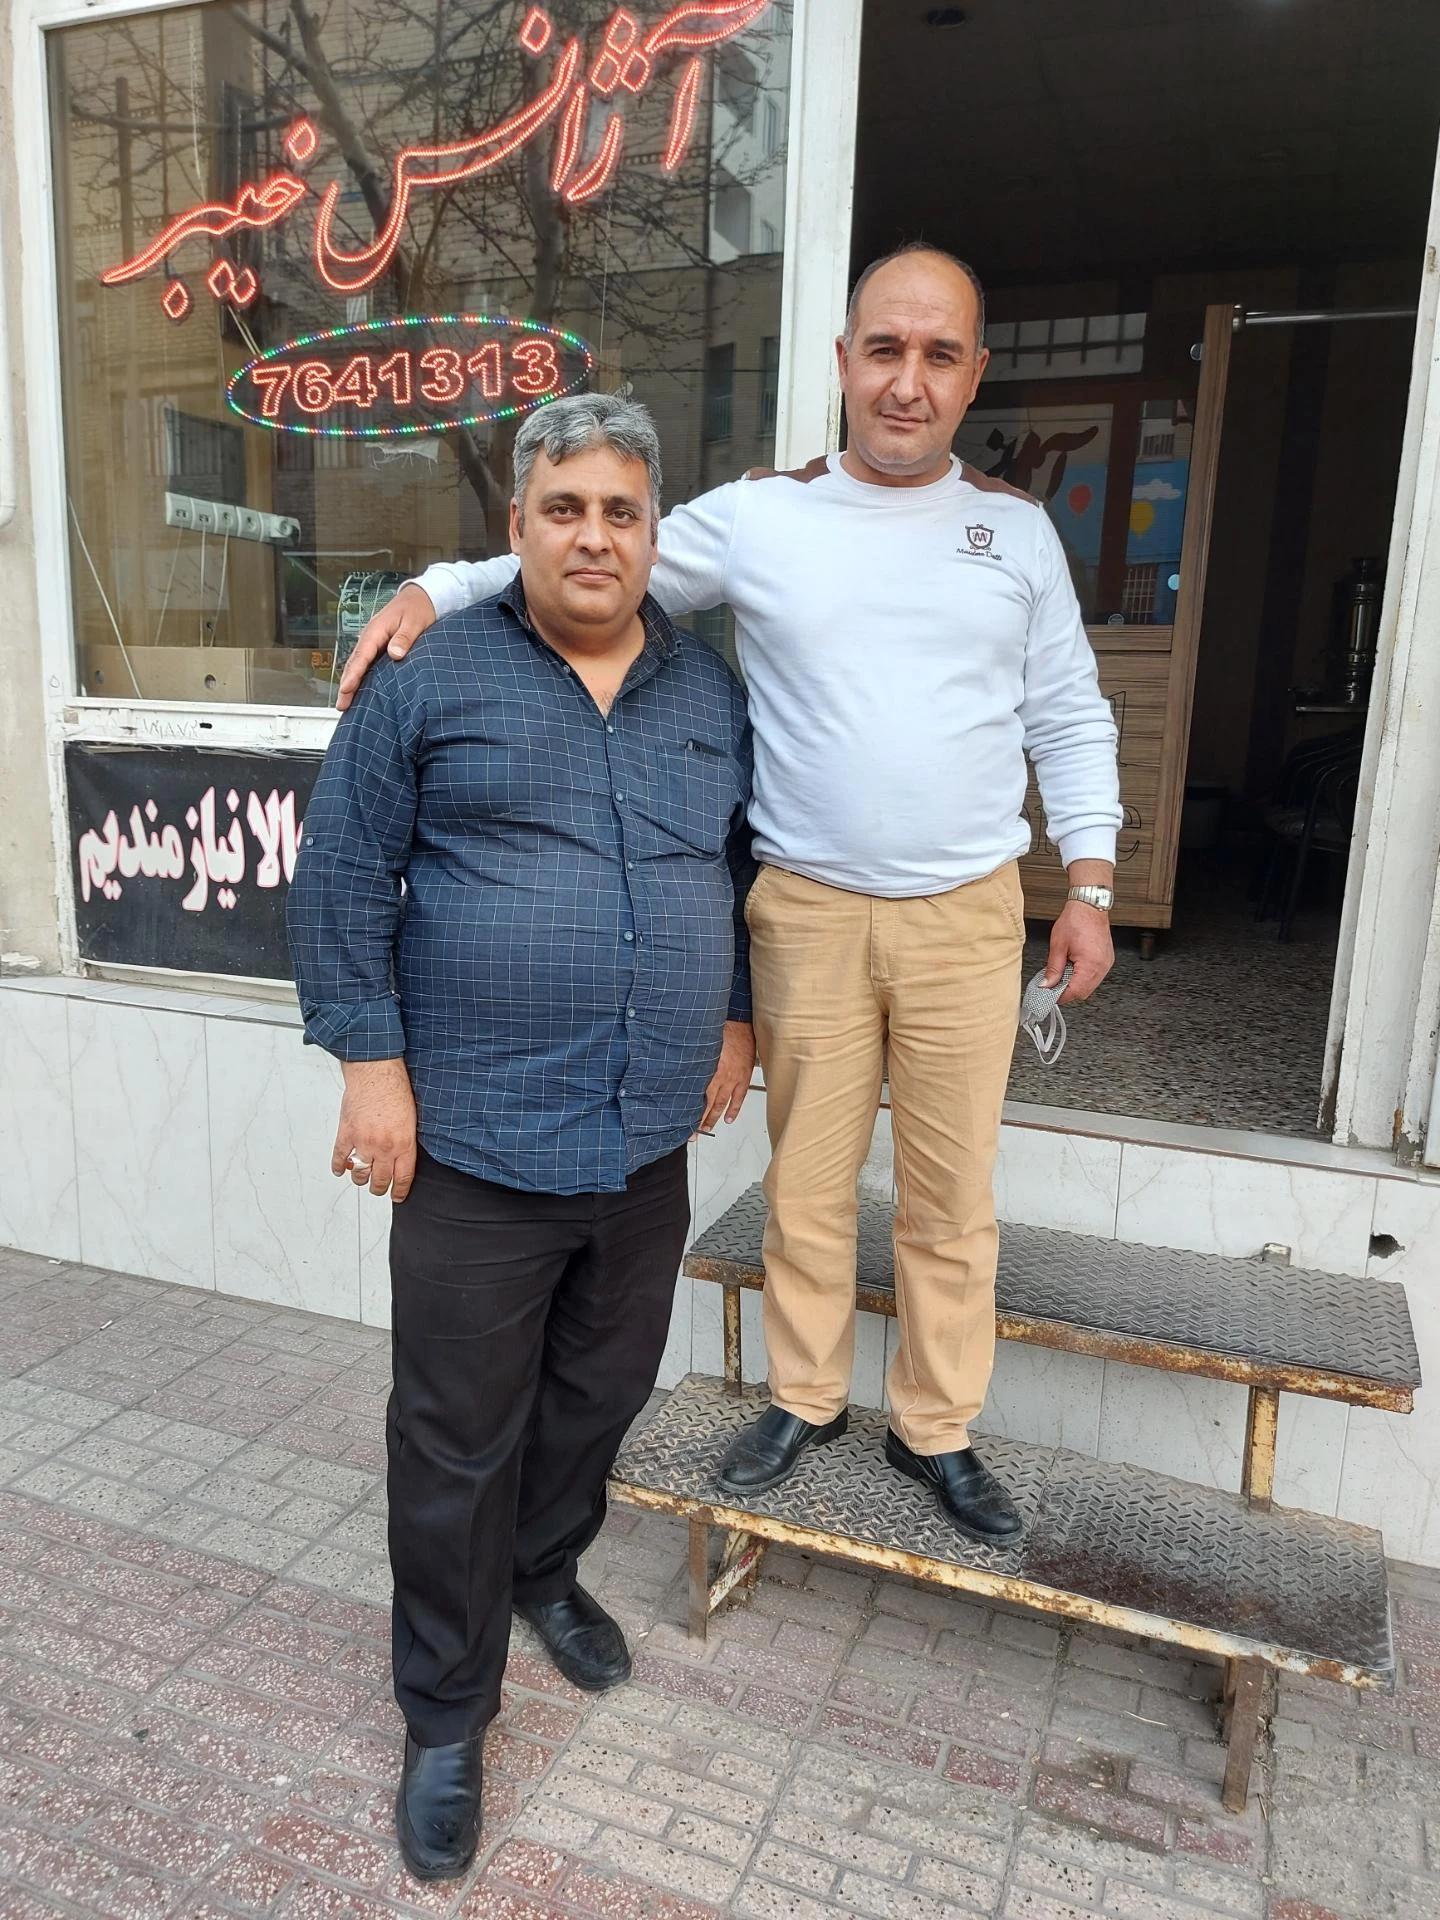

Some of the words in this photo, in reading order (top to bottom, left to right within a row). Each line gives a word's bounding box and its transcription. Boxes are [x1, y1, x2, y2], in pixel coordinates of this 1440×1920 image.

[102, 121, 316, 319] خیبر
[317, 0, 768, 290] آژانس
[251, 338, 561, 417] 7641313
